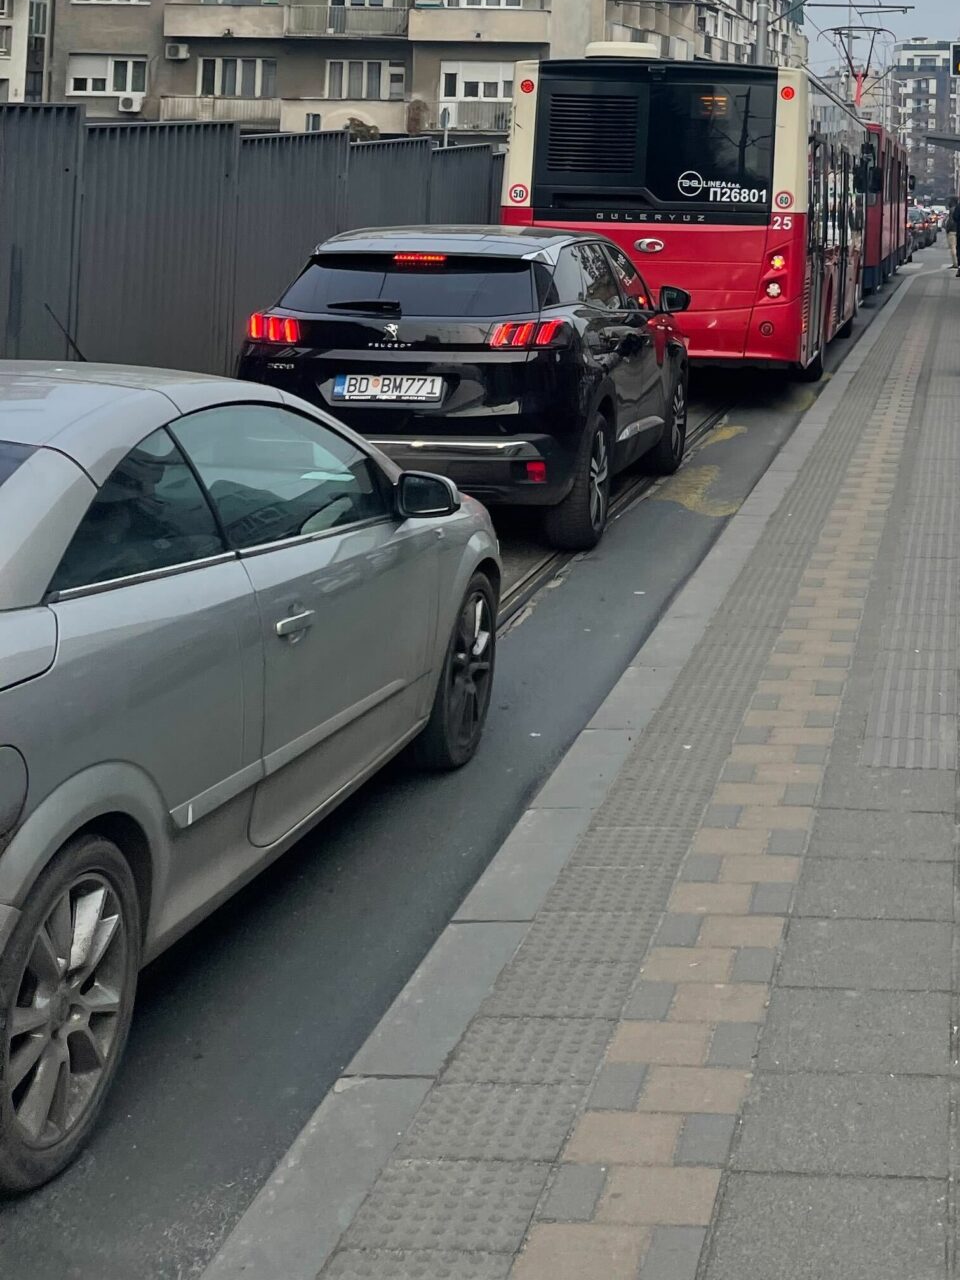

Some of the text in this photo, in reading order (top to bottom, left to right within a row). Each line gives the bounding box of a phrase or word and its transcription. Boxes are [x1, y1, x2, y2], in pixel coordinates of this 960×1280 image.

[513, 189, 525, 199] 50
[709, 188, 767, 203] П26801
[779, 195, 789, 205] 60
[772, 216, 792, 230] 25
[347, 377, 437, 395] BD BM771
